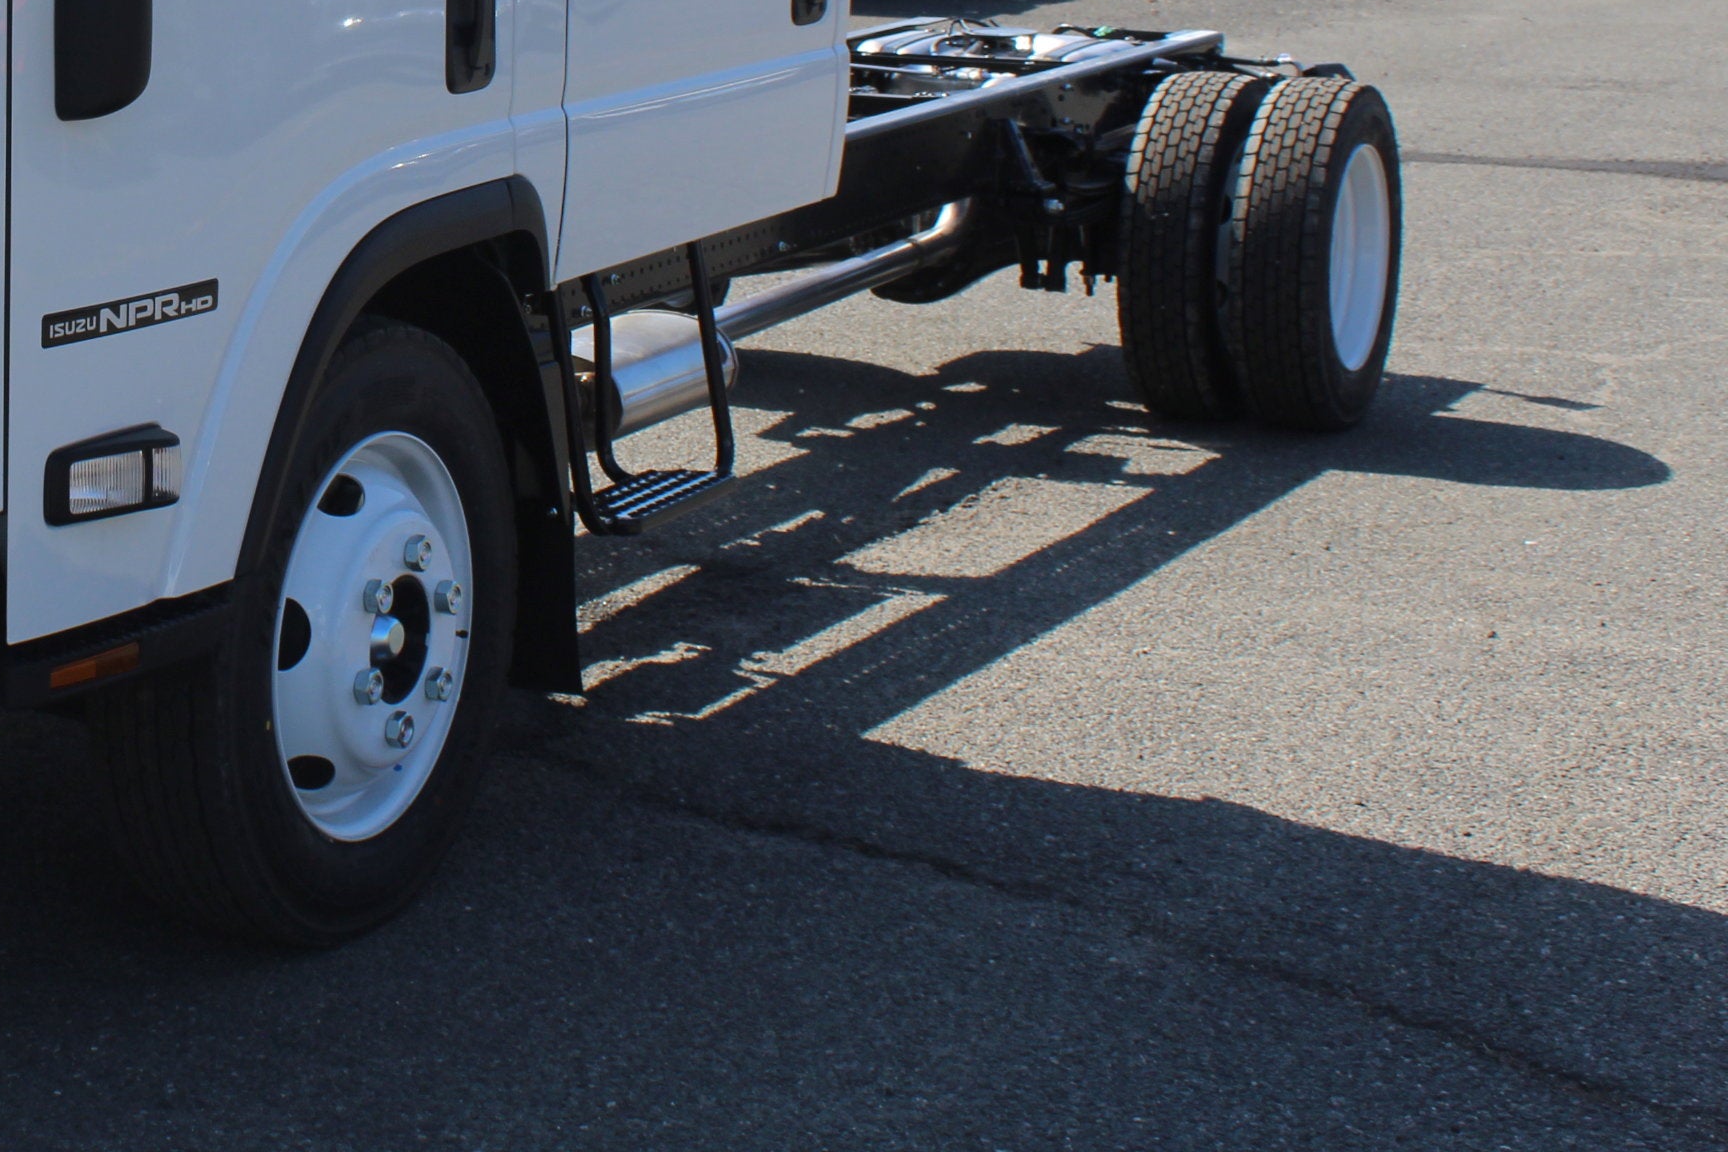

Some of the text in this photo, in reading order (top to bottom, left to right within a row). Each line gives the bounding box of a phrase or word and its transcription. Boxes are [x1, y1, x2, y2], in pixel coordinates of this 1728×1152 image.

[49, 292, 213, 339] ISUZU NPR HD
